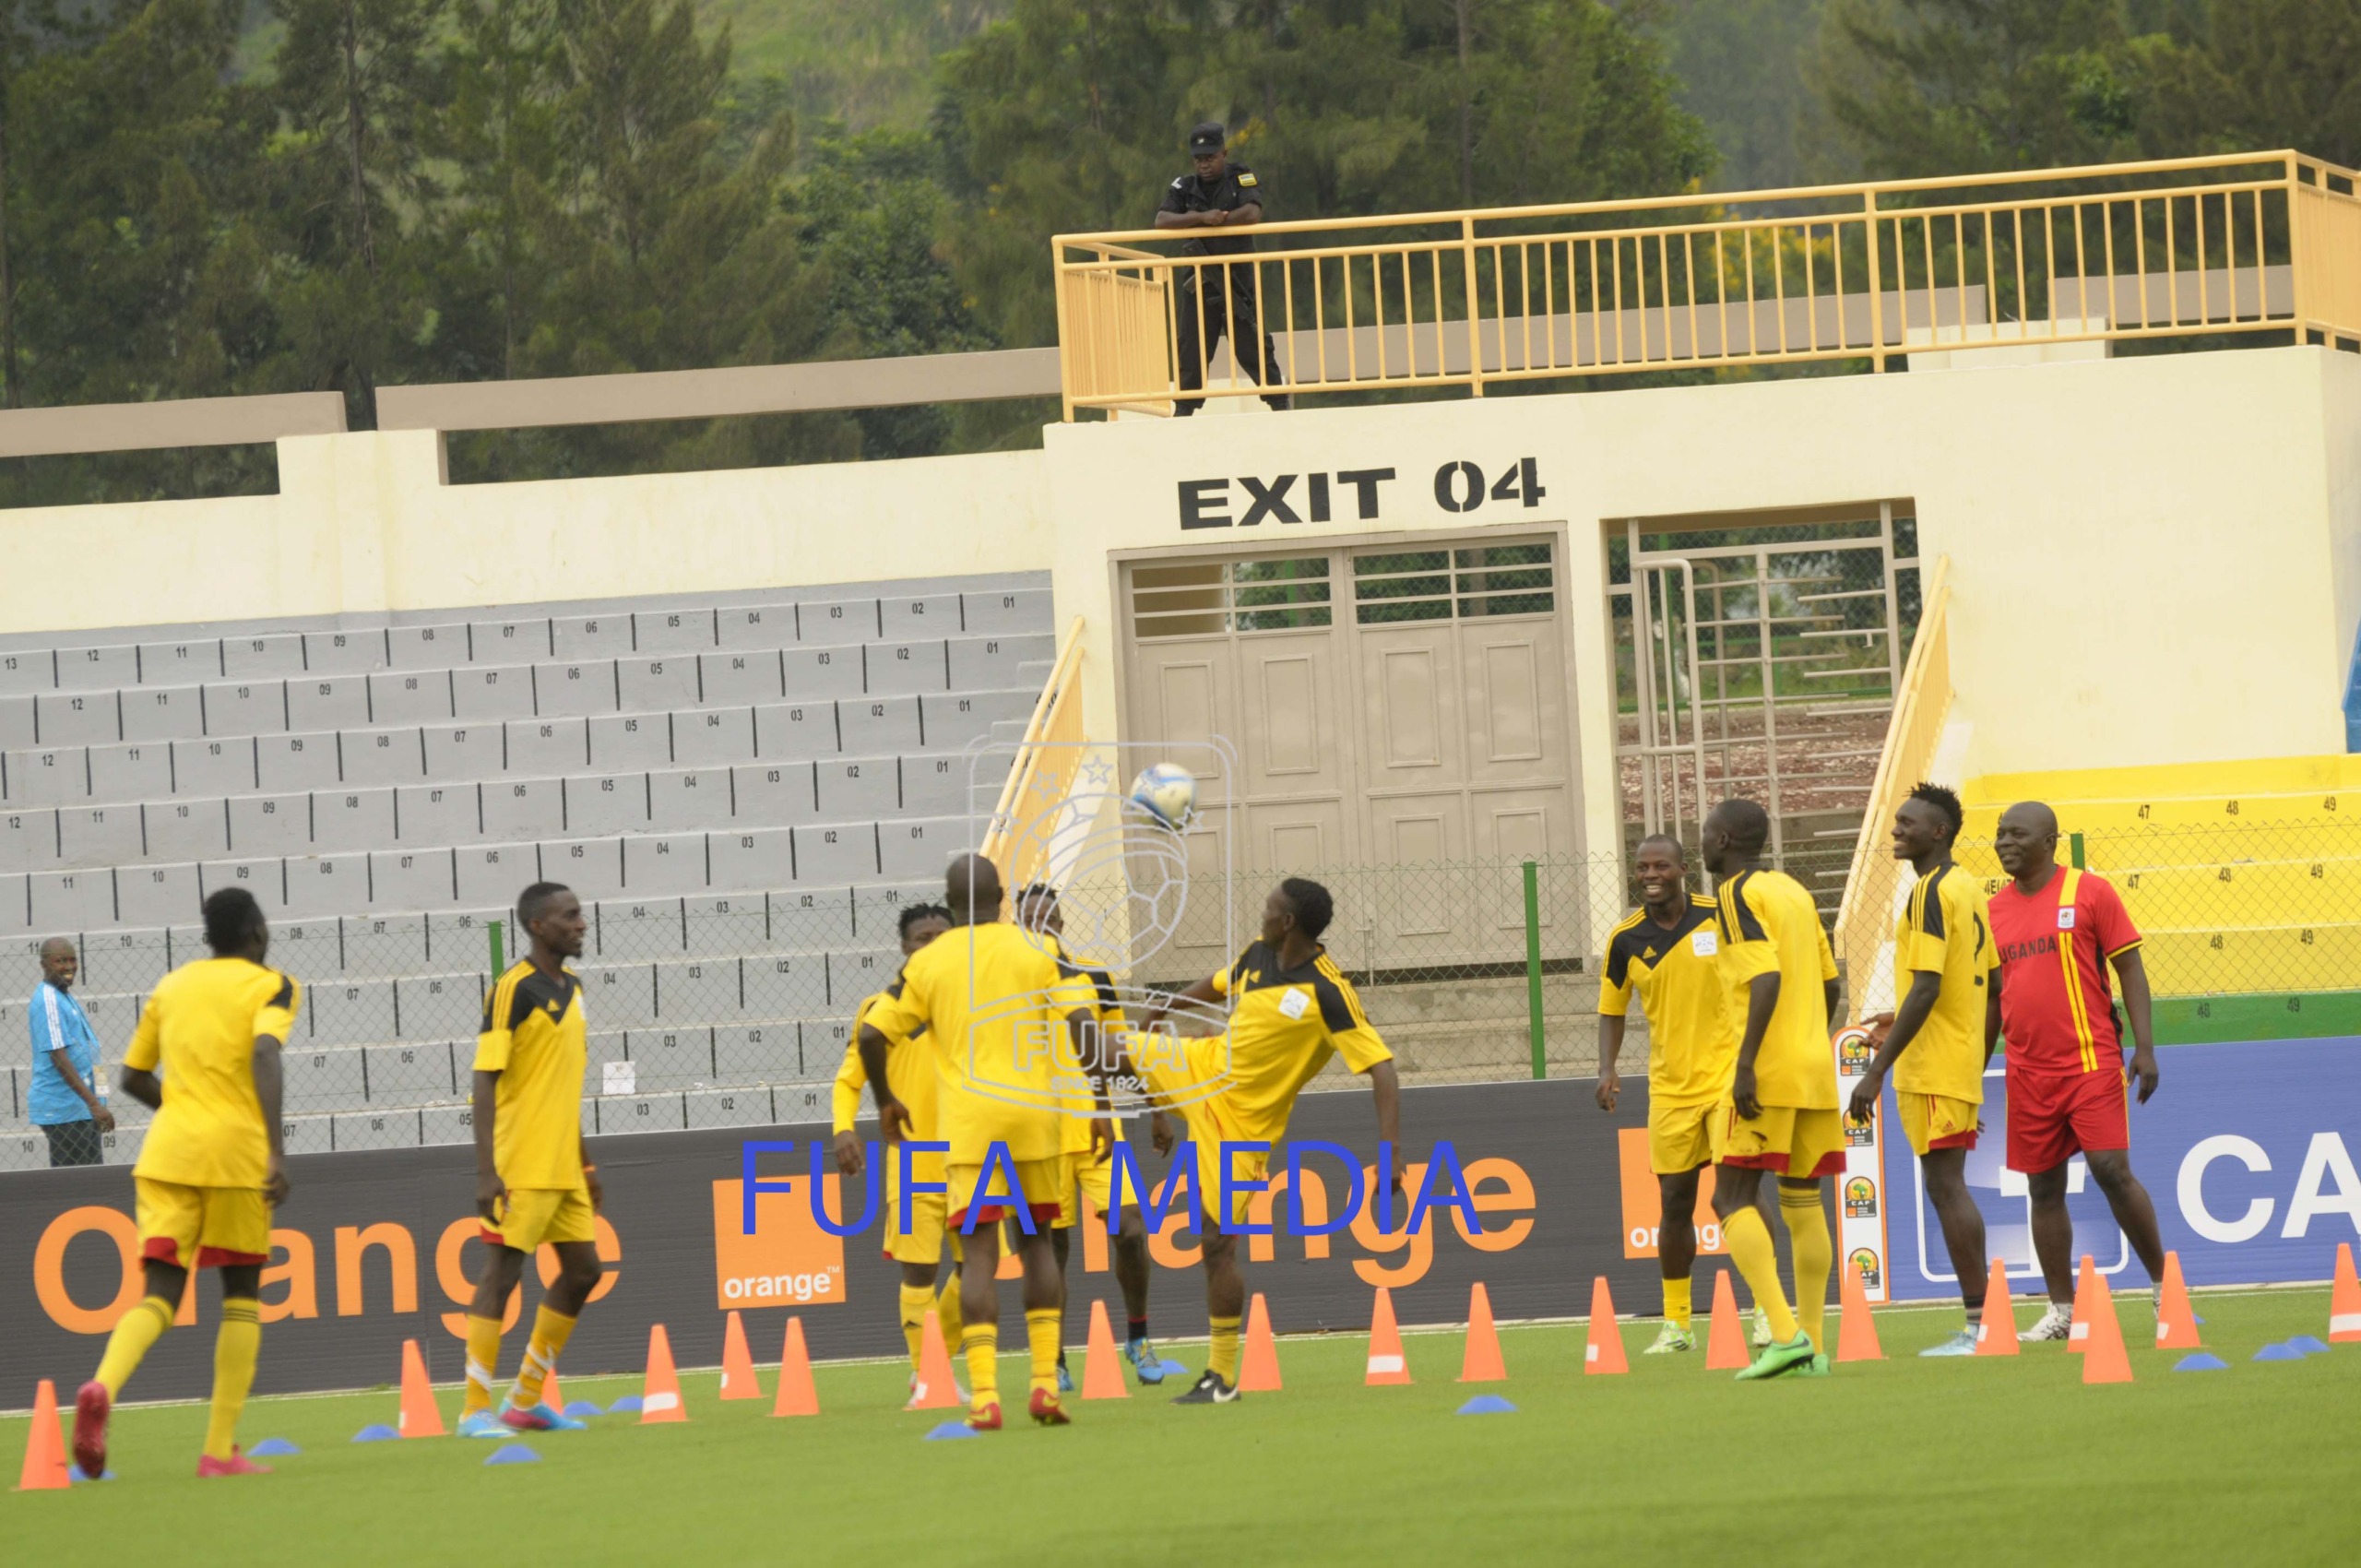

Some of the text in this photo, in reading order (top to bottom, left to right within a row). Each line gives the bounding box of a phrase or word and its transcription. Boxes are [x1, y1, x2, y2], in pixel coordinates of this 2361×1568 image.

[1178, 457, 1547, 531] EXIT 04
[5, 596, 1015, 671] 13 12 11 10 09 08 07 06 05 04 03 02 01
[71, 641, 999, 711] 12 11 10 09 08 07 06 05 04 03 02 01
[42, 699, 971, 766] 12 11 10 09 08 07 06 05 04 03 02 01
[8, 760, 948, 829] 12 11 10 09 08 07 06 05 04 03 02 01
[2138, 796, 2337, 820] 47 48 49
[62, 826, 923, 889] 11 10 09 08 07 06 05 04 03 02 01
[2127, 873, 2141, 890] 47
[2218, 867, 2232, 884] 48
[2310, 863, 2323, 879] 49
[27, 889, 898, 955] 11 10 08 07 06 04 03 02 01
[1999, 935, 2058, 965] UGANDA
[2210, 929, 2314, 950] 48 49
[86, 1001, 99, 1015] 10
[346, 987, 360, 1001] 07
[429, 980, 443, 994] 06
[603, 972, 616, 985] 04
[688, 966, 702, 980] 03
[777, 960, 789, 974] 02
[861, 956, 873, 968] 01
[313, 1026, 845, 1069] 07 06 03 02 01
[21, 1093, 817, 1153] 10 09 07 06 05 03 02 01
[2177, 1131, 2361, 1243] CA
[34, 1206, 622, 1341] Oange
[724, 1273, 831, 1301] orange
